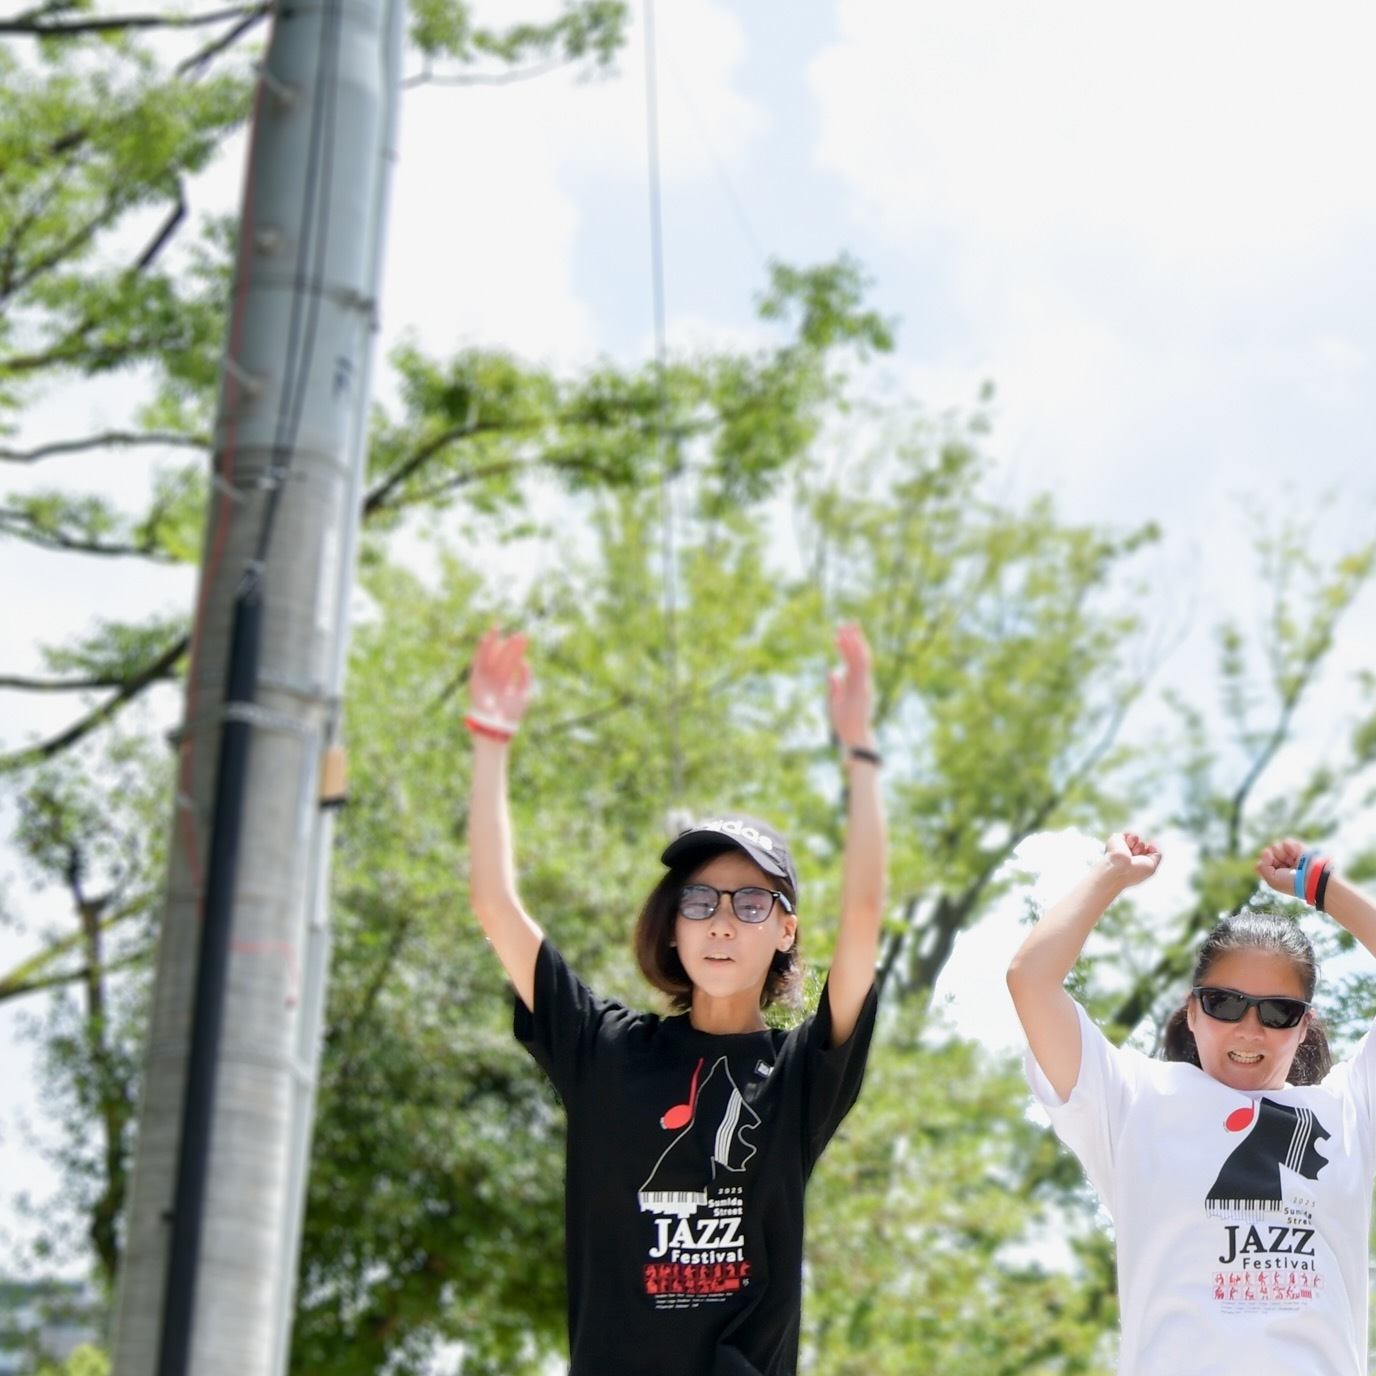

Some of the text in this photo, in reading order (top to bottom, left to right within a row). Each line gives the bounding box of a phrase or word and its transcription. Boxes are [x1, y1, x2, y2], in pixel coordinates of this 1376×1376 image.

[699, 819, 773, 851] didas
[718, 1187, 743, 1195] 2025
[708, 1197, 743, 1208] Sumida
[713, 1207, 743, 1217] Street
[648, 1217, 744, 1258] JAZZ
[1218, 1224, 1315, 1264] JAZZ
[671, 1248, 744, 1264] Festival
[1243, 1257, 1315, 1272] Festival
